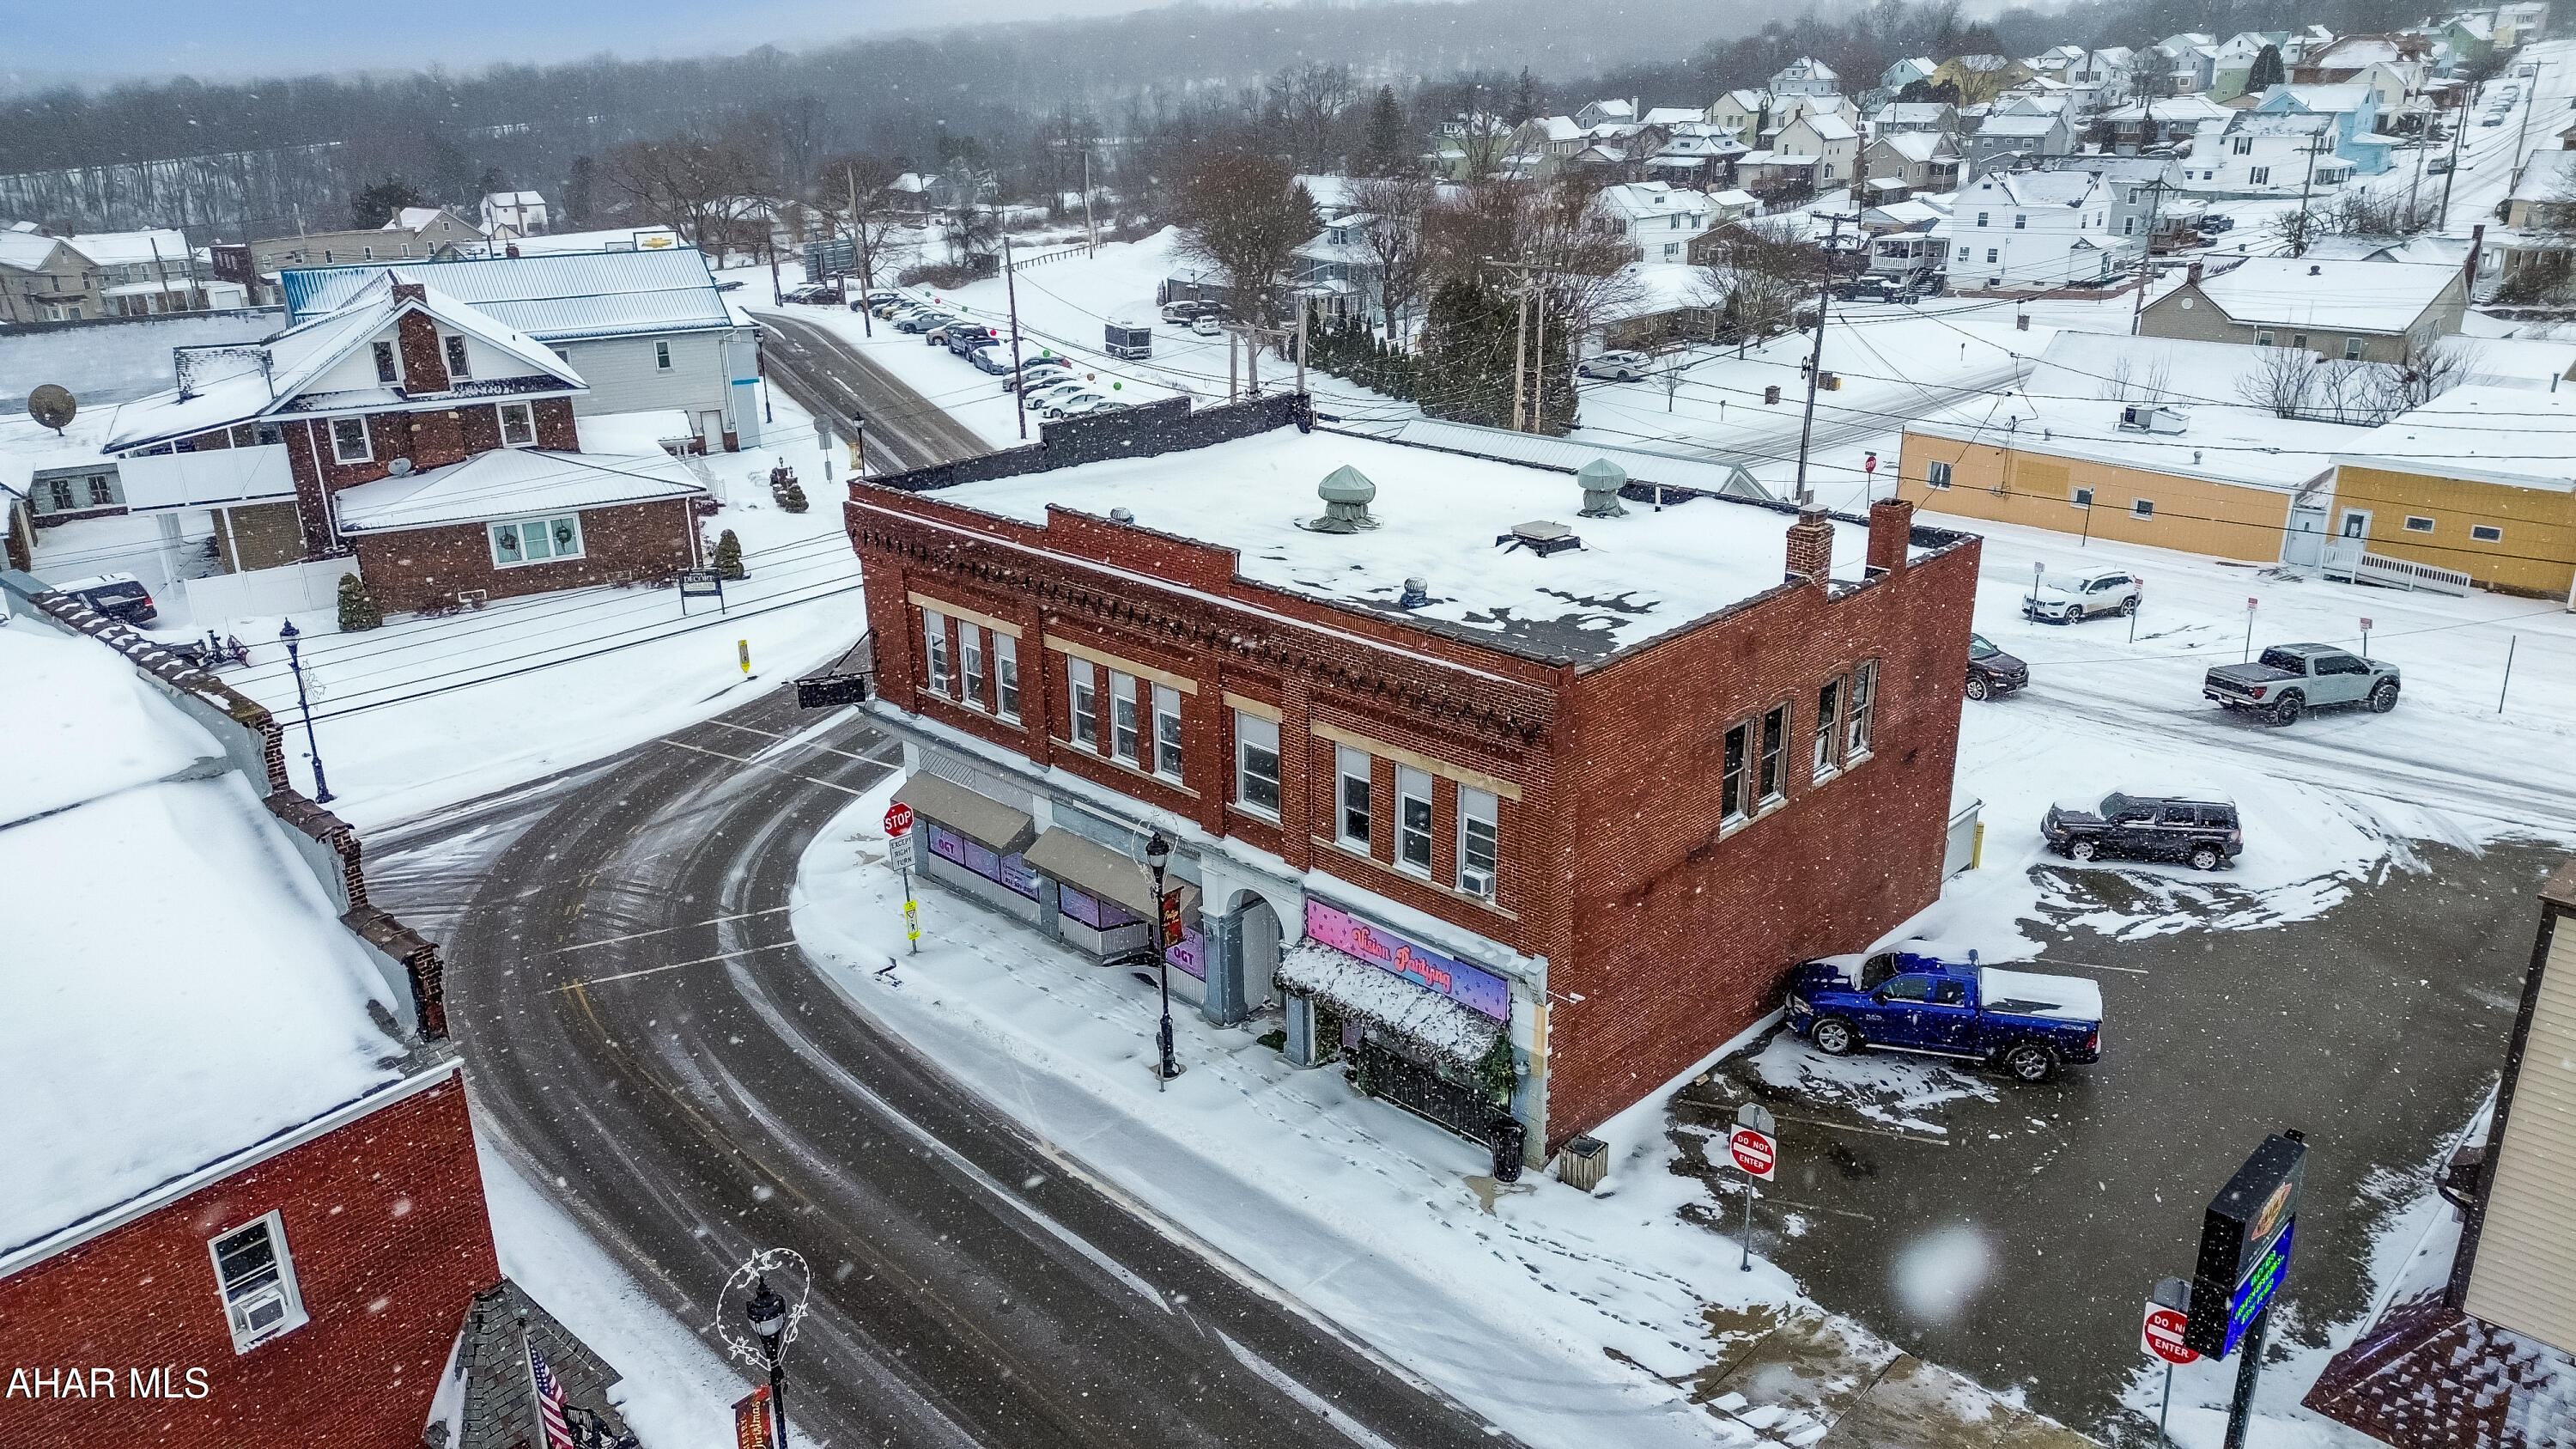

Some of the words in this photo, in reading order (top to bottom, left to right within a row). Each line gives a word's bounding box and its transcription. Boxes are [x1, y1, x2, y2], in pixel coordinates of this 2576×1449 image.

[885, 810, 911, 830] STOP
[890, 837, 912, 849] EXCEPT
[894, 846, 912, 858] RIGHT
[896, 856, 912, 867] TURN
[1352, 927, 1392, 962] Vision
[1737, 1135, 1749, 1146] DO
[1753, 1140, 1770, 1153] NOT
[1739, 1154, 1765, 1170] ENTER
[2154, 1314, 2169, 1328] DO
[2154, 1338, 2190, 1359] ENTER
